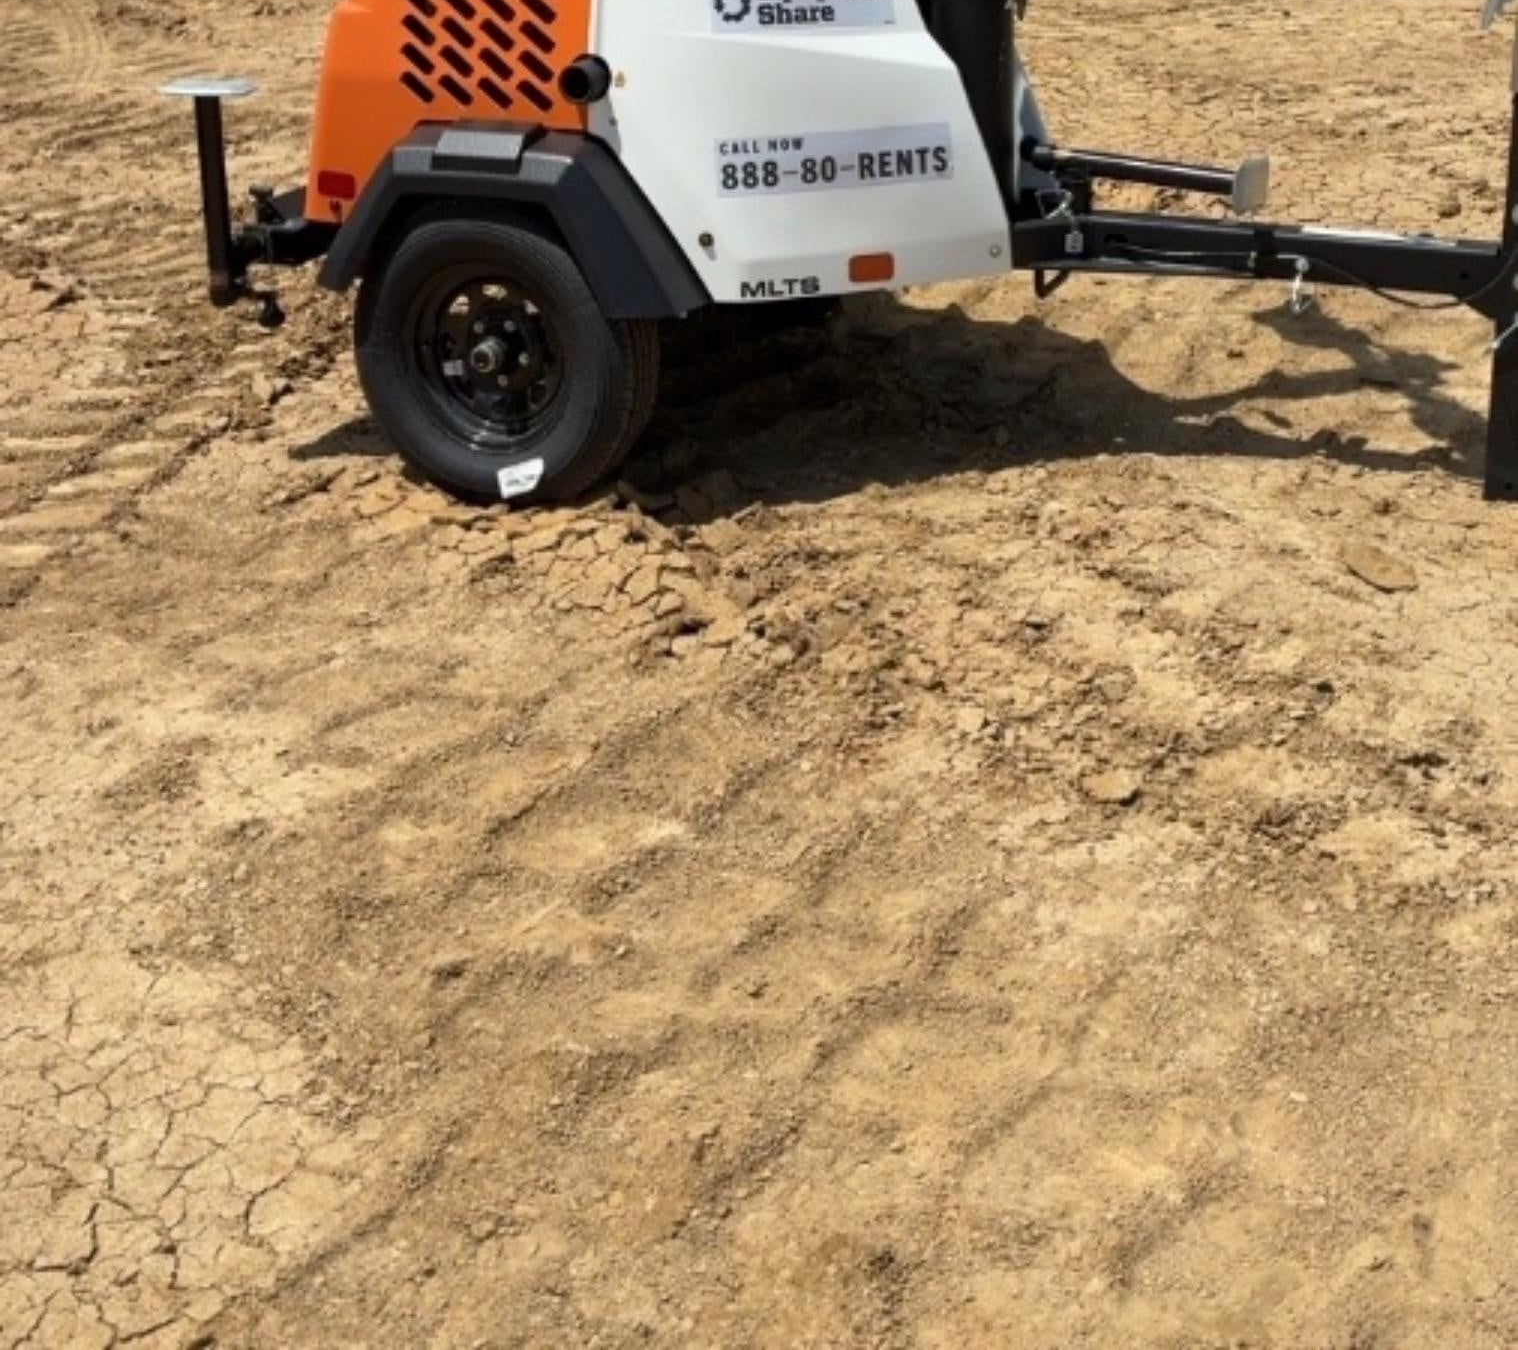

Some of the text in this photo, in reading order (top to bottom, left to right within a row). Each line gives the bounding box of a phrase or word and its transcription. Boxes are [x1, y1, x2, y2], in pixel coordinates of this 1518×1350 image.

[757, 1, 835, 25] Share
[719, 137, 804, 155] CALL NOW
[721, 146, 949, 190] 888-80-RENTS
